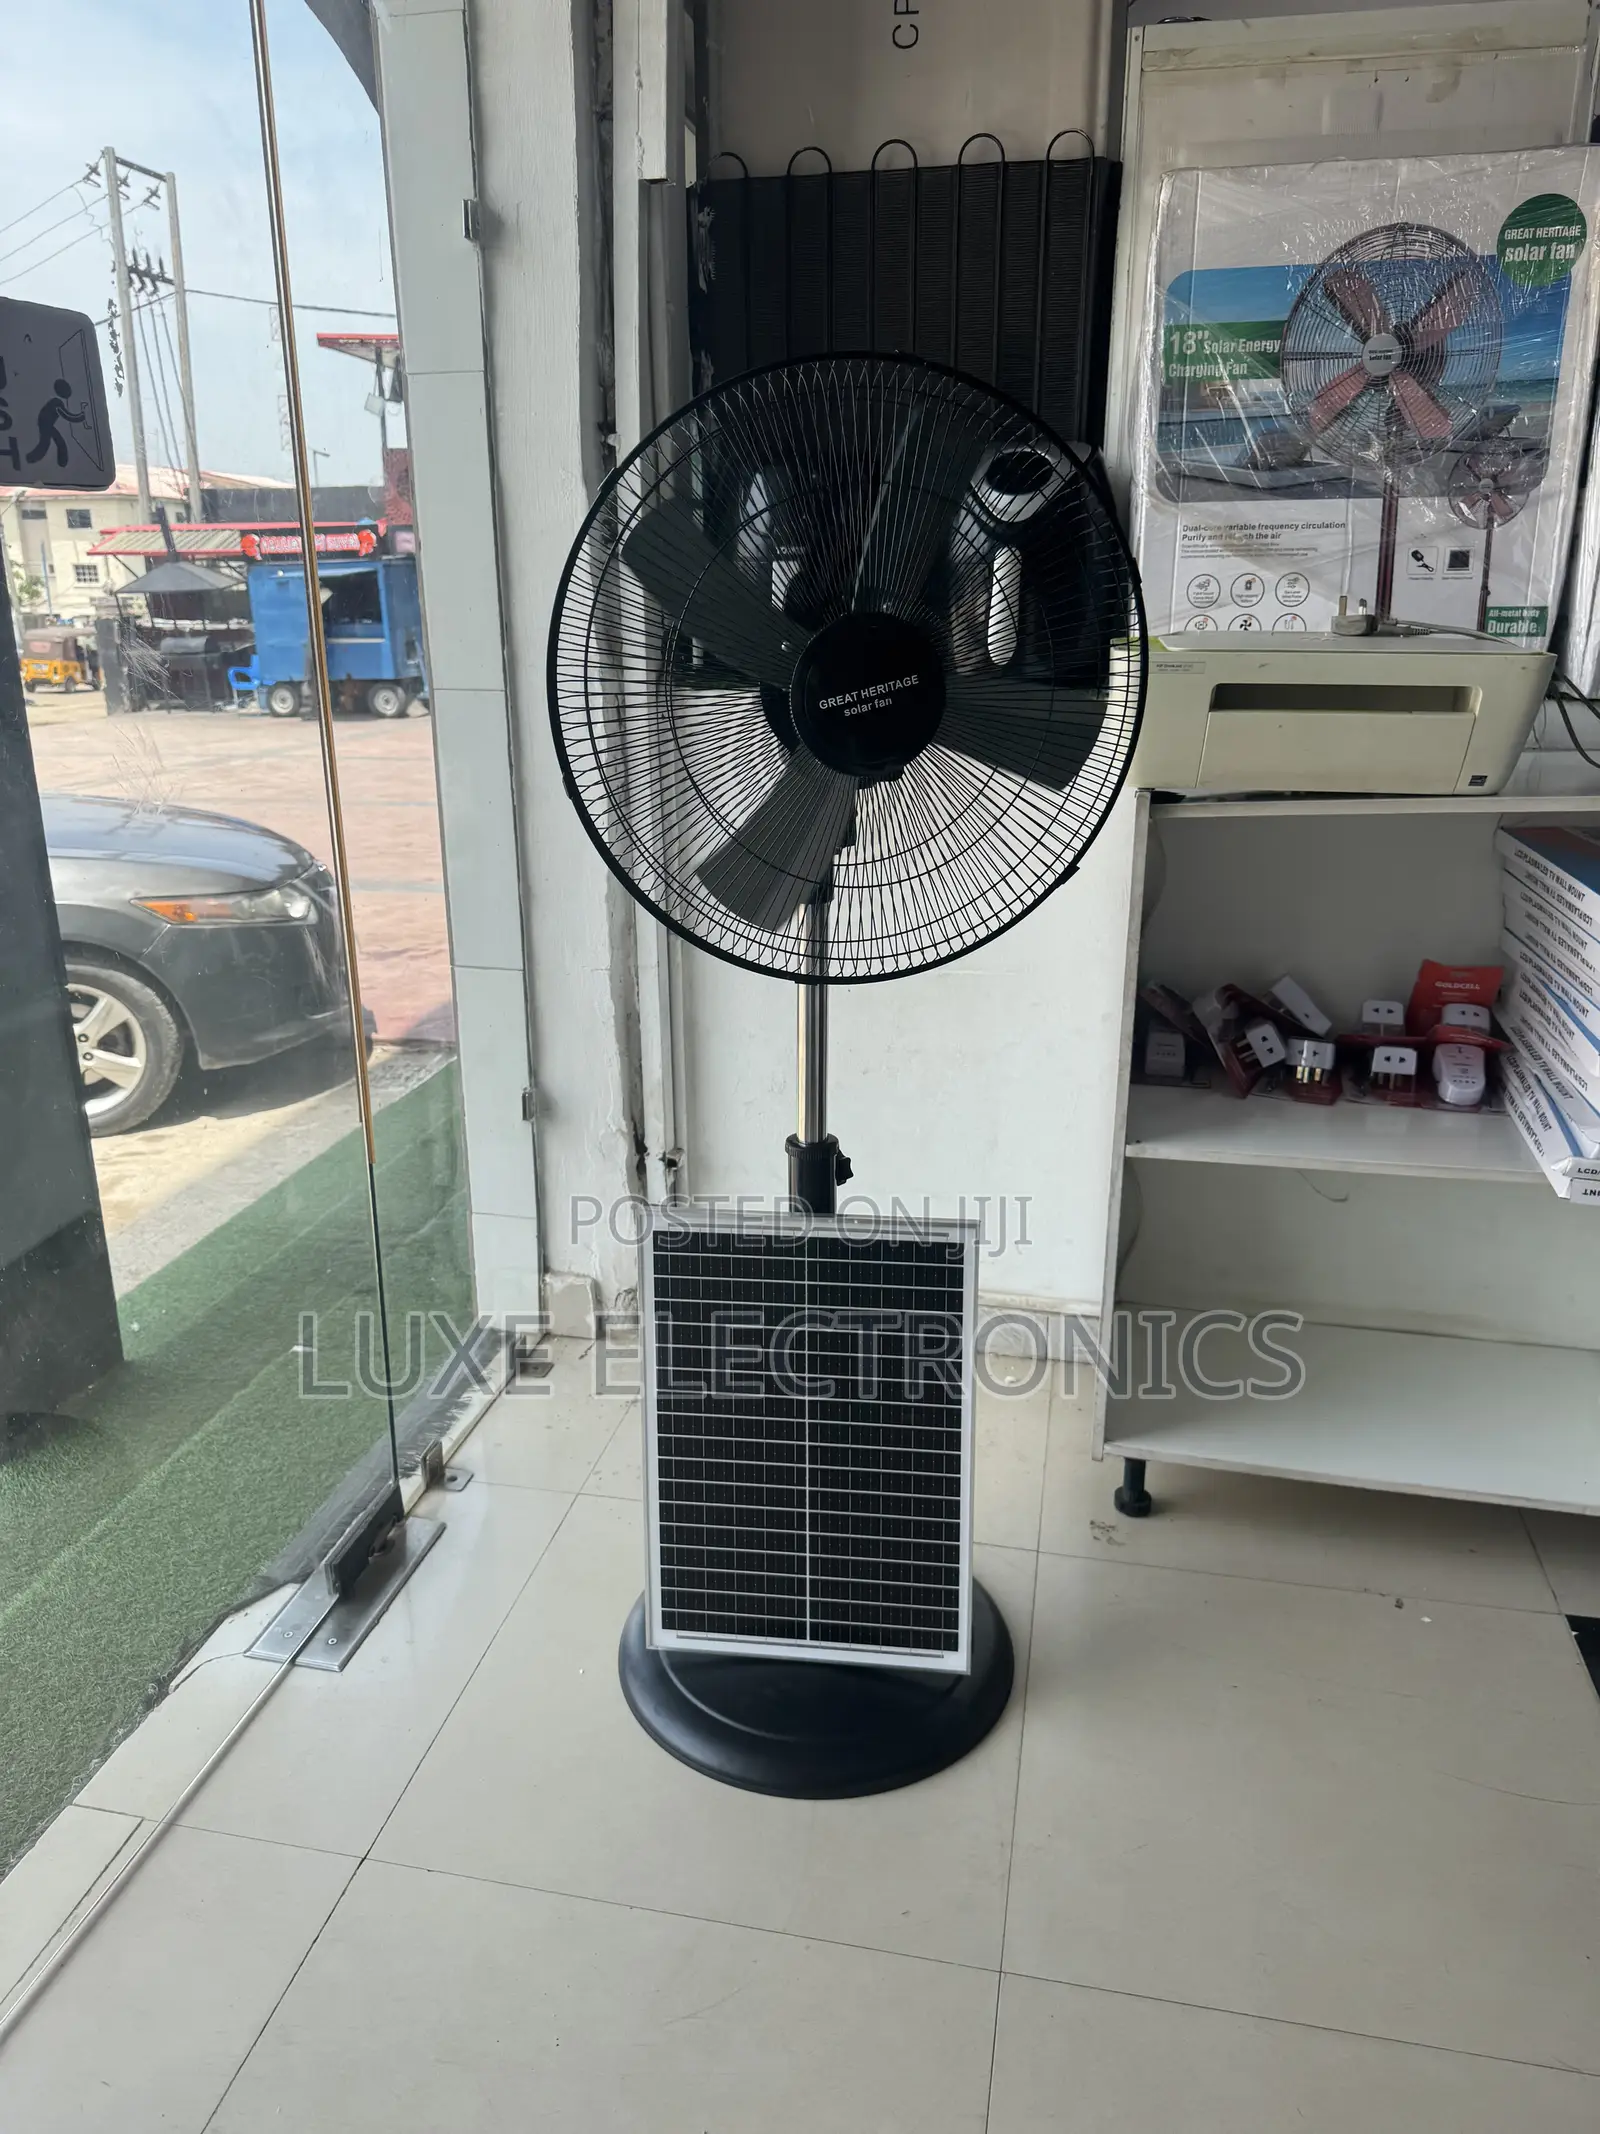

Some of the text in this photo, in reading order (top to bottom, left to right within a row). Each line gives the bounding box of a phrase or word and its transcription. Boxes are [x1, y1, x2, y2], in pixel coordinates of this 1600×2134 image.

[1504, 225, 1581, 240] GREAT HERITAGE
[1504, 241, 1577, 262] solar fan
[1203, 339, 1237, 354] Solar
[1238, 338, 1281, 353] Energy
[1168, 361, 1248, 378] Charging Fan
[1224, 523, 1256, 531] variable
[1258, 522, 1299, 532] frequency
[1301, 521, 1346, 530] circulation
[1181, 533, 1206, 542] Purify
[1208, 532, 1223, 540] and
[1255, 532, 1269, 540] the
[1488, 609, 1521, 618] All-metal
[1487, 620, 1538, 633] Durable
[818, 674, 919, 709] GREAT HERITAGE
[844, 698, 893, 717] solar fan
[1566, 883, 1585, 902] MOUNT
[1571, 930, 1588, 950] MOUNT
[1571, 996, 1589, 1018] MOUNT
[1536, 1111, 1552, 1133] MOUNT
